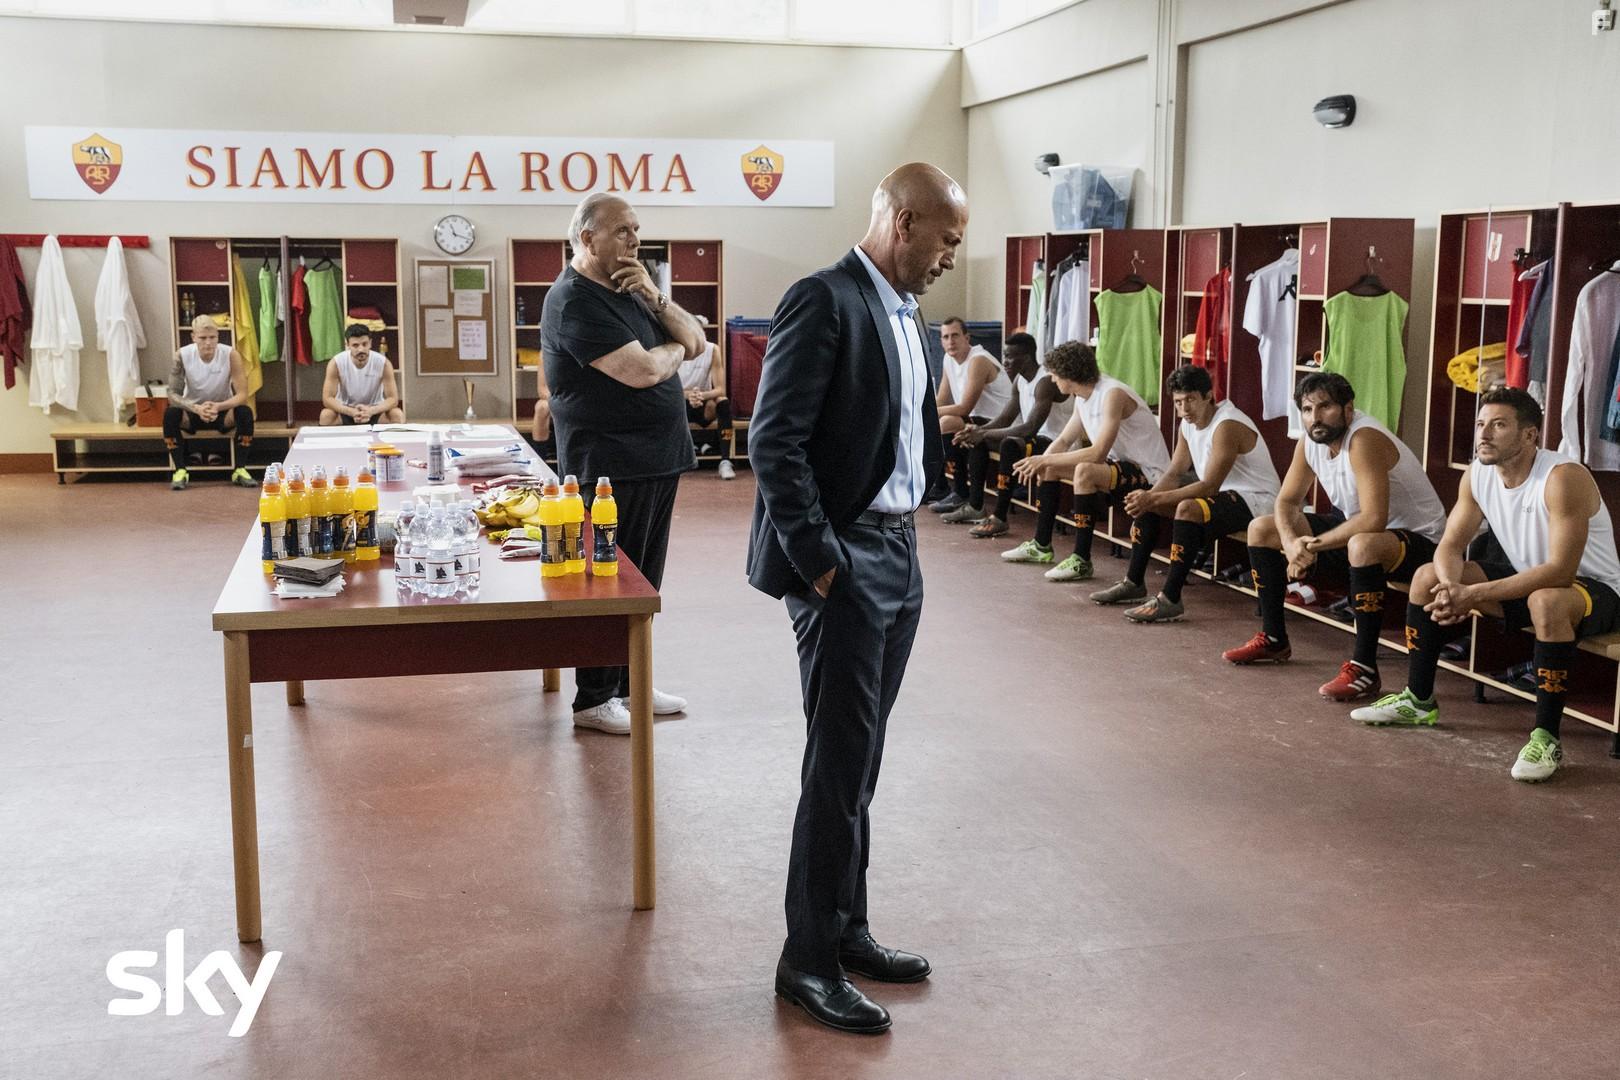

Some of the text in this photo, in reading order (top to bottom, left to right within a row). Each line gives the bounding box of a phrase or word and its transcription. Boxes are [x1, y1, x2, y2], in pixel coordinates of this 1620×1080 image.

[185, 145, 697, 193] SIAMO LA ROMA
